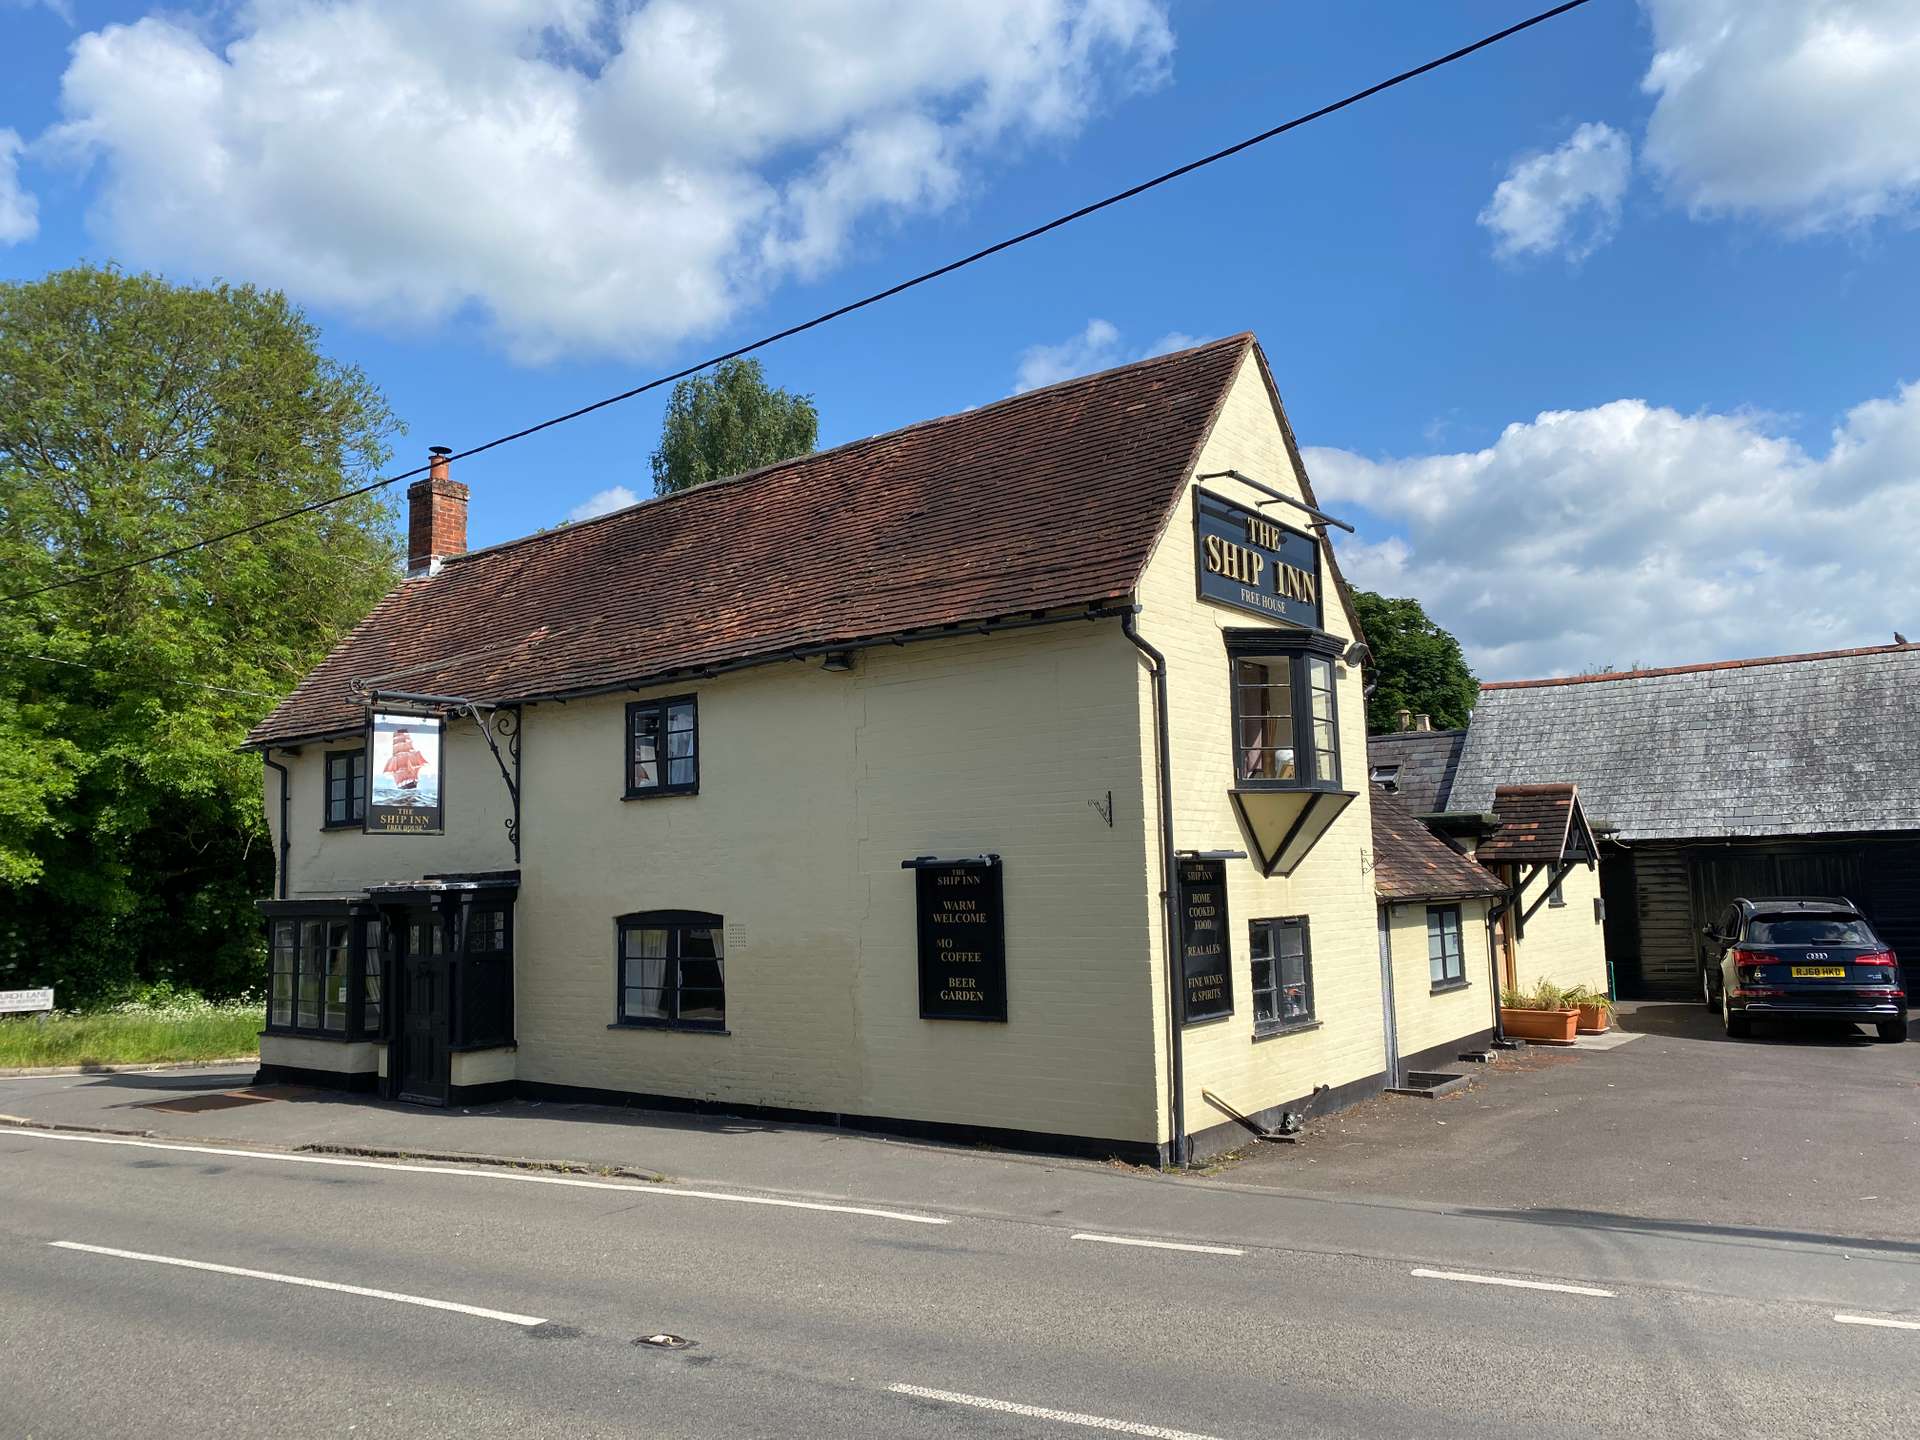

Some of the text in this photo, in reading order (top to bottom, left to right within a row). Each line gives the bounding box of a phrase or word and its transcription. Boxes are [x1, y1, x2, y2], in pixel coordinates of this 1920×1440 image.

[1246, 516, 1281, 552] THE
[1207, 534, 1316, 606] SHIP INN
[1240, 588, 1287, 614] FREE HOUSE
[380, 815, 430, 824] SHIP INN
[937, 875, 981, 886] SHIP INN
[1187, 871, 1214, 881] SHIP INN
[1192, 893, 1212, 904] HOME
[943, 900, 976, 911] WARM
[933, 912, 987, 924] WELCOME
[1188, 906, 1216, 918] COOKED
[1194, 919, 1212, 931] FOOD
[1187, 943, 1221, 957] REAL ALES
[940, 952, 982, 963] COFFEE
[948, 977, 976, 988] BEER
[1187, 974, 1224, 989] FINE WINES
[940, 990, 984, 1001] GARDEN
[1198, 988, 1223, 1001] SPIRITS
